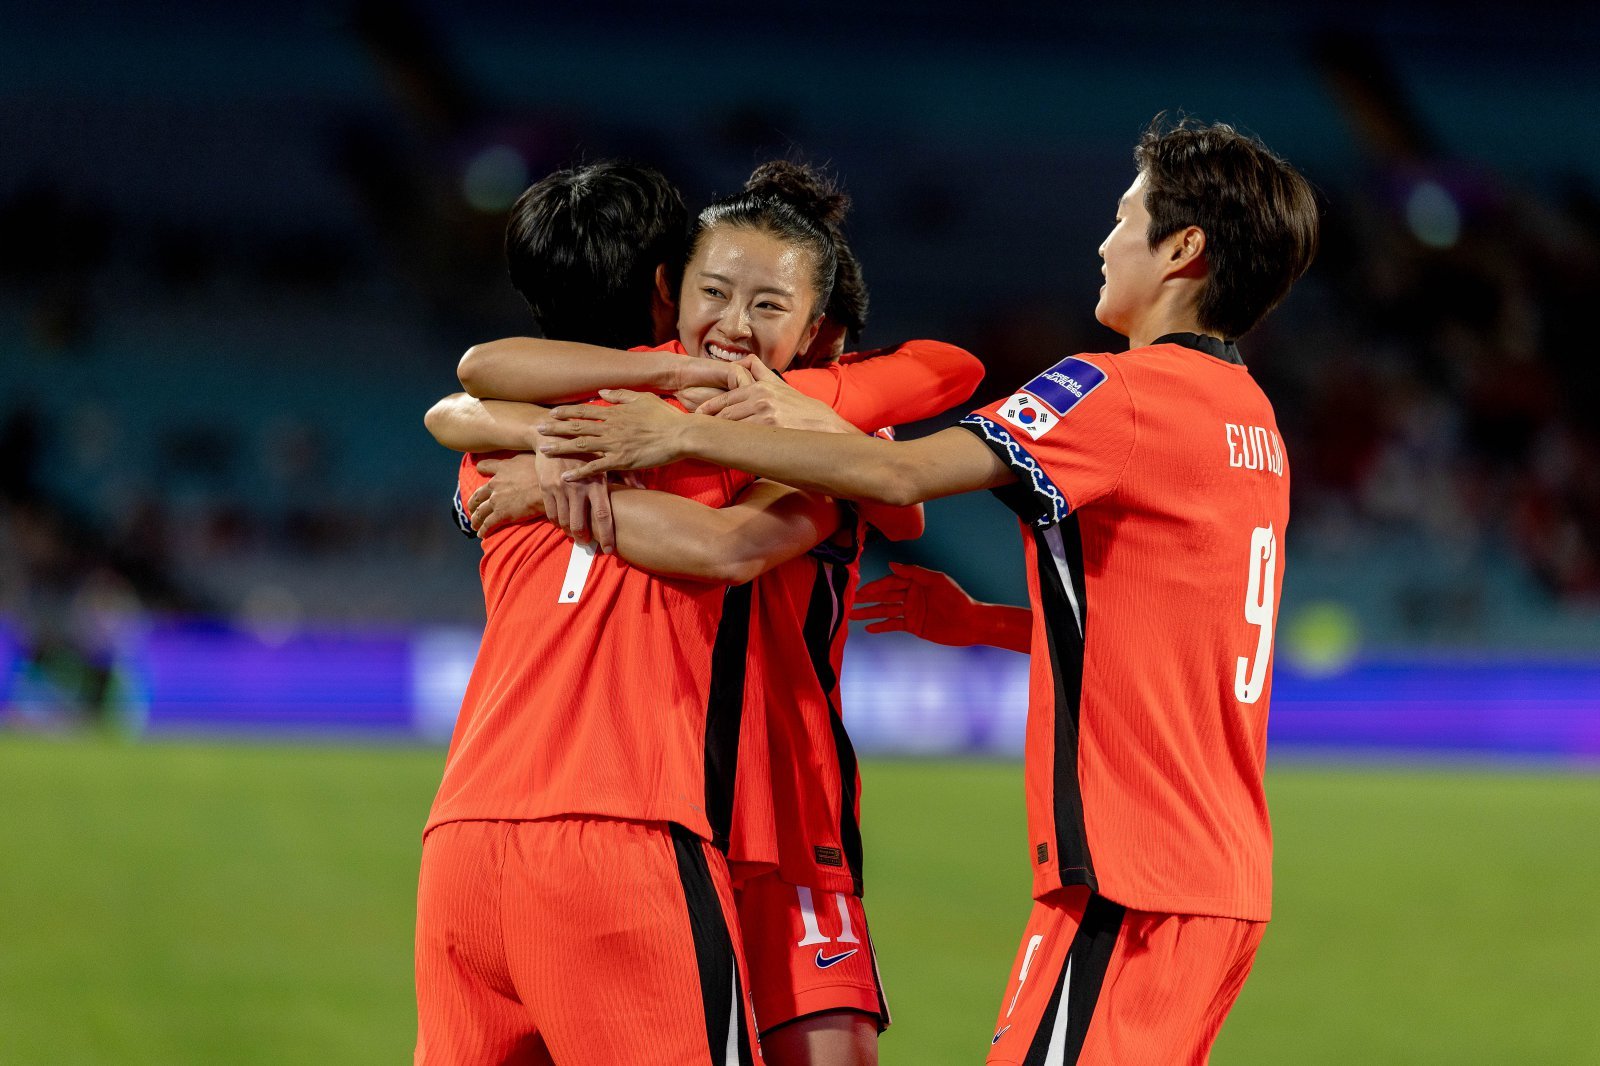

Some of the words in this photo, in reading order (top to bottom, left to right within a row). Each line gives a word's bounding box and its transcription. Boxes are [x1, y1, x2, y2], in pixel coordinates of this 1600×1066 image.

[1041, 373, 1083, 398] FEARLESS
[1052, 371, 1082, 390] DREAM
[1234, 521, 1276, 704] 9
[796, 885, 860, 947] 11
[1006, 934, 1044, 1018] 9
